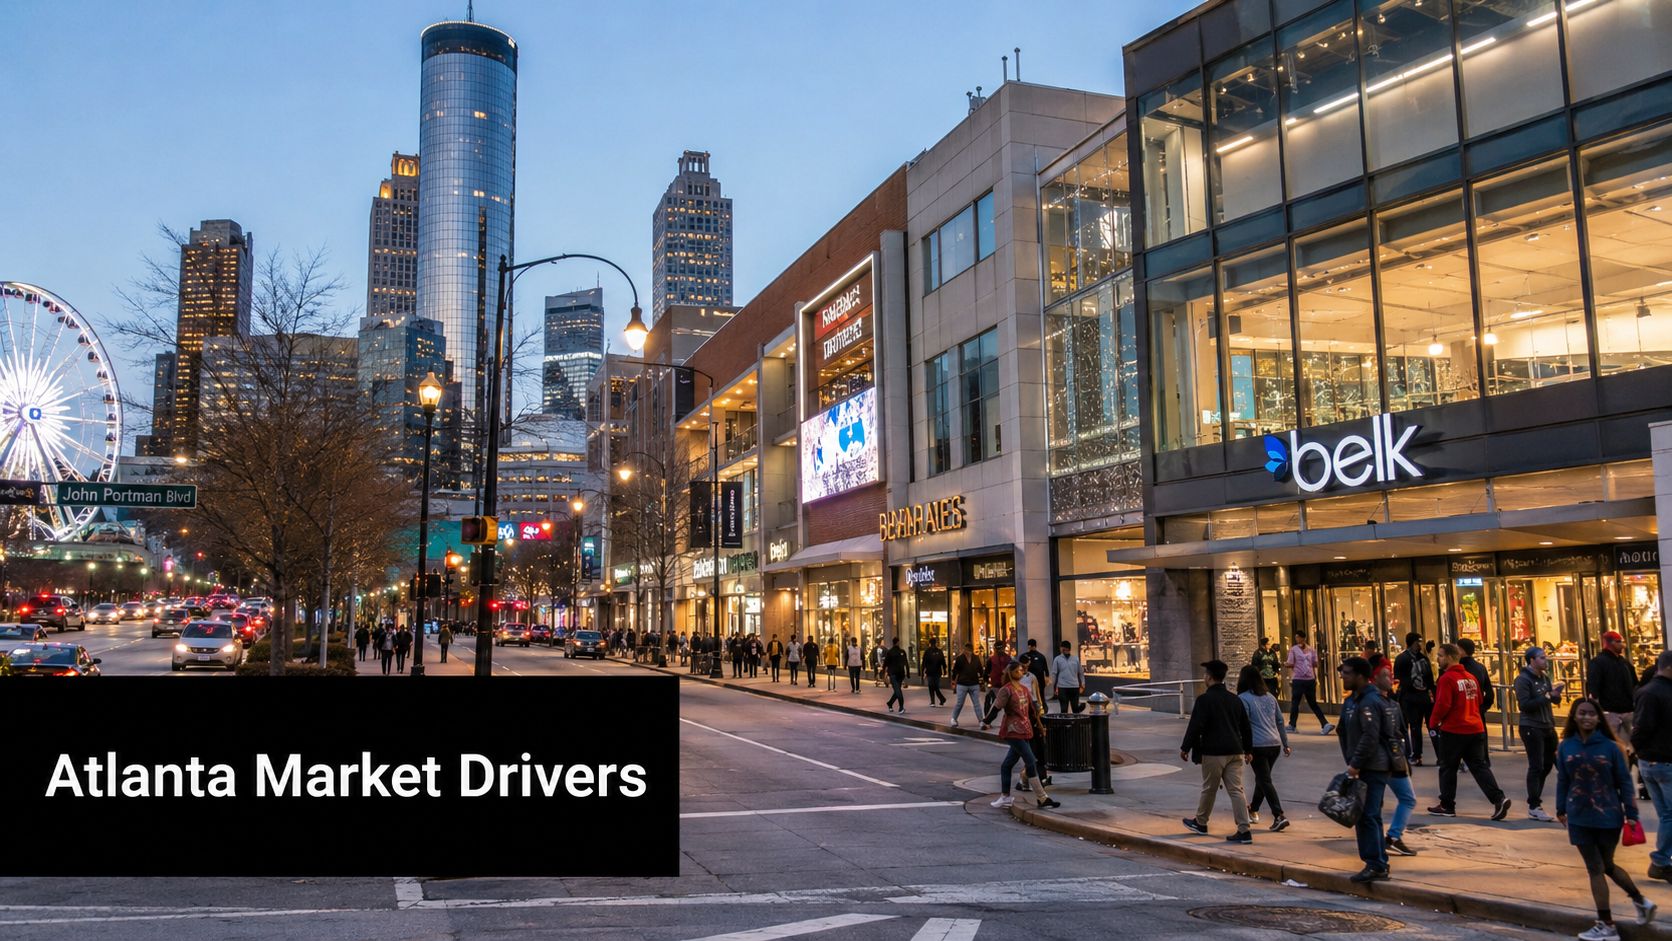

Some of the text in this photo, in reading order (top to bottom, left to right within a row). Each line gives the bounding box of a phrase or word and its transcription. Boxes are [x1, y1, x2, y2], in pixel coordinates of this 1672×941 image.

[1290, 413, 1424, 492] belk
[62, 486, 191, 503] John Portman Blvd
